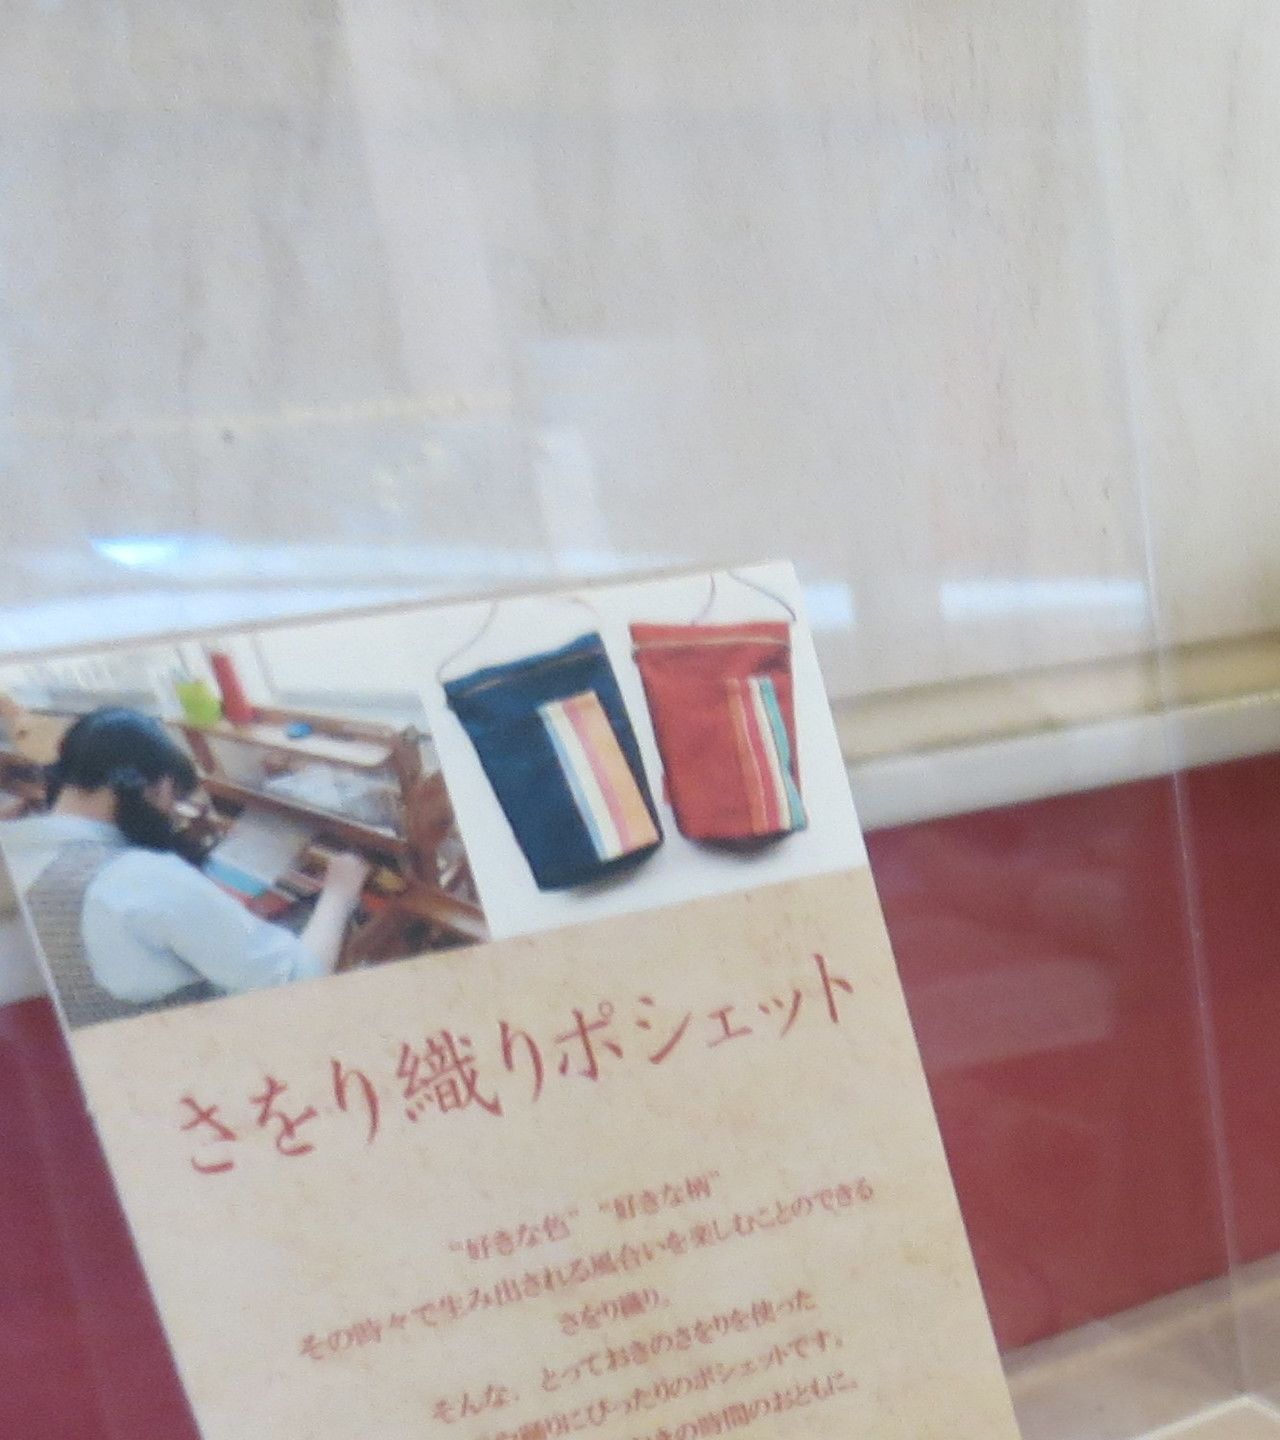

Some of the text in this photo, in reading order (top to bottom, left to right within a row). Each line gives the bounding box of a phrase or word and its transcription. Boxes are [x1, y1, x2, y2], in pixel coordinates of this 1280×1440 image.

[178, 952, 854, 1176] さをり織りポシェット
